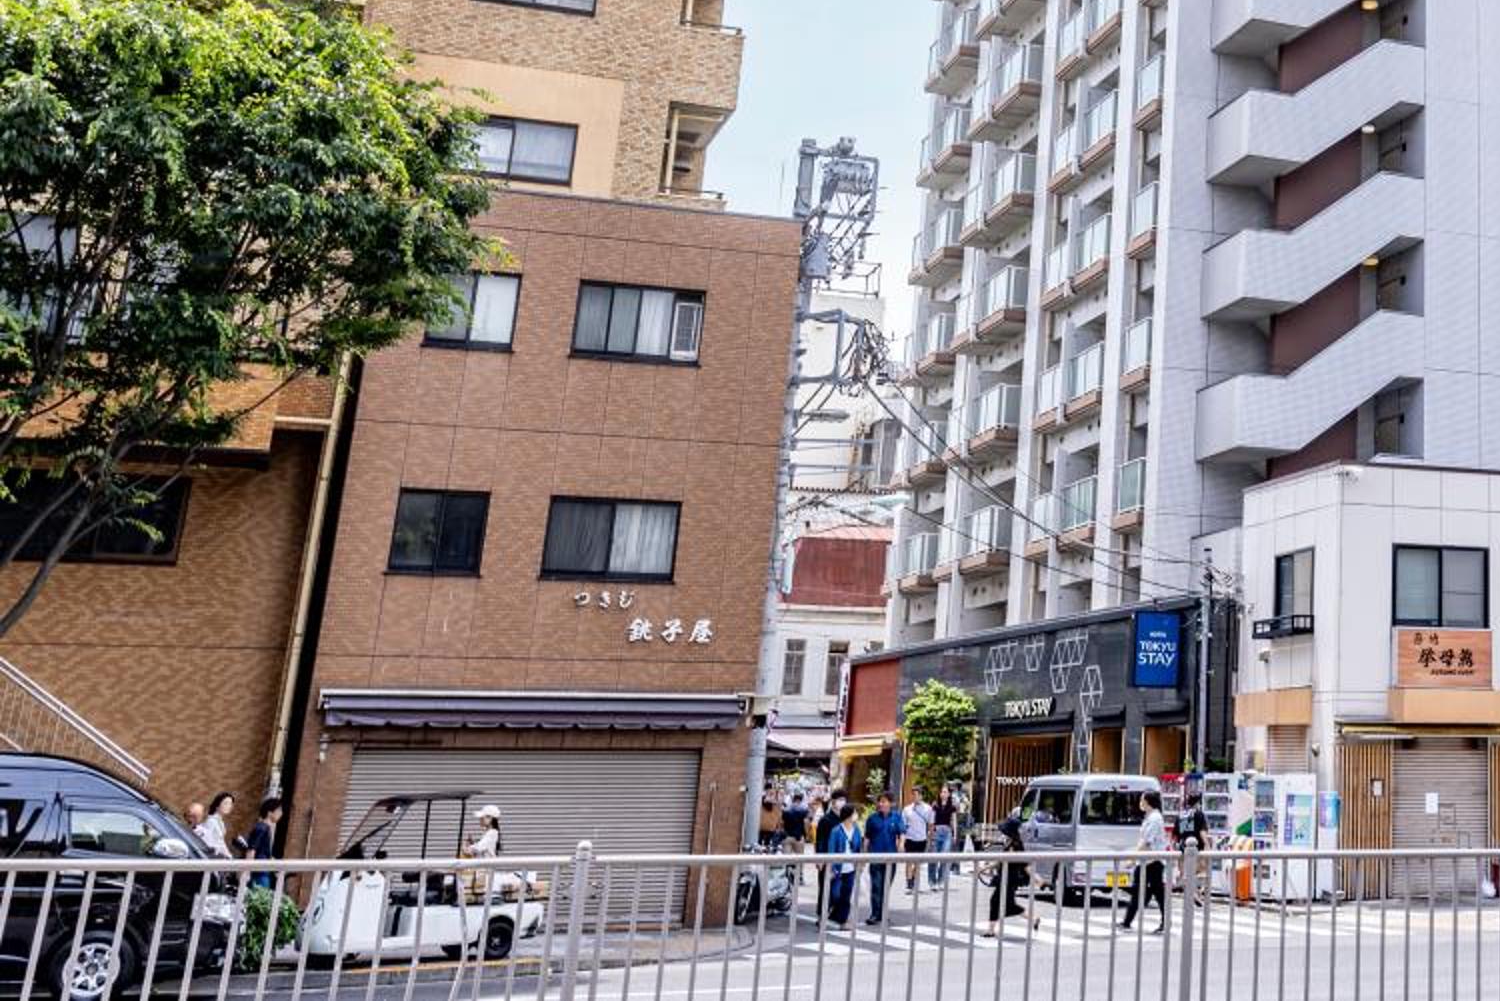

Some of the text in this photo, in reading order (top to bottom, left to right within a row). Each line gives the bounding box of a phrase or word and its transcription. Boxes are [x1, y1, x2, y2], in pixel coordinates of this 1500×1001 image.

[1139, 640, 1178, 653] TOKYU
[1137, 652, 1175, 668] STAY
[1031, 696, 1053, 716] STAY
